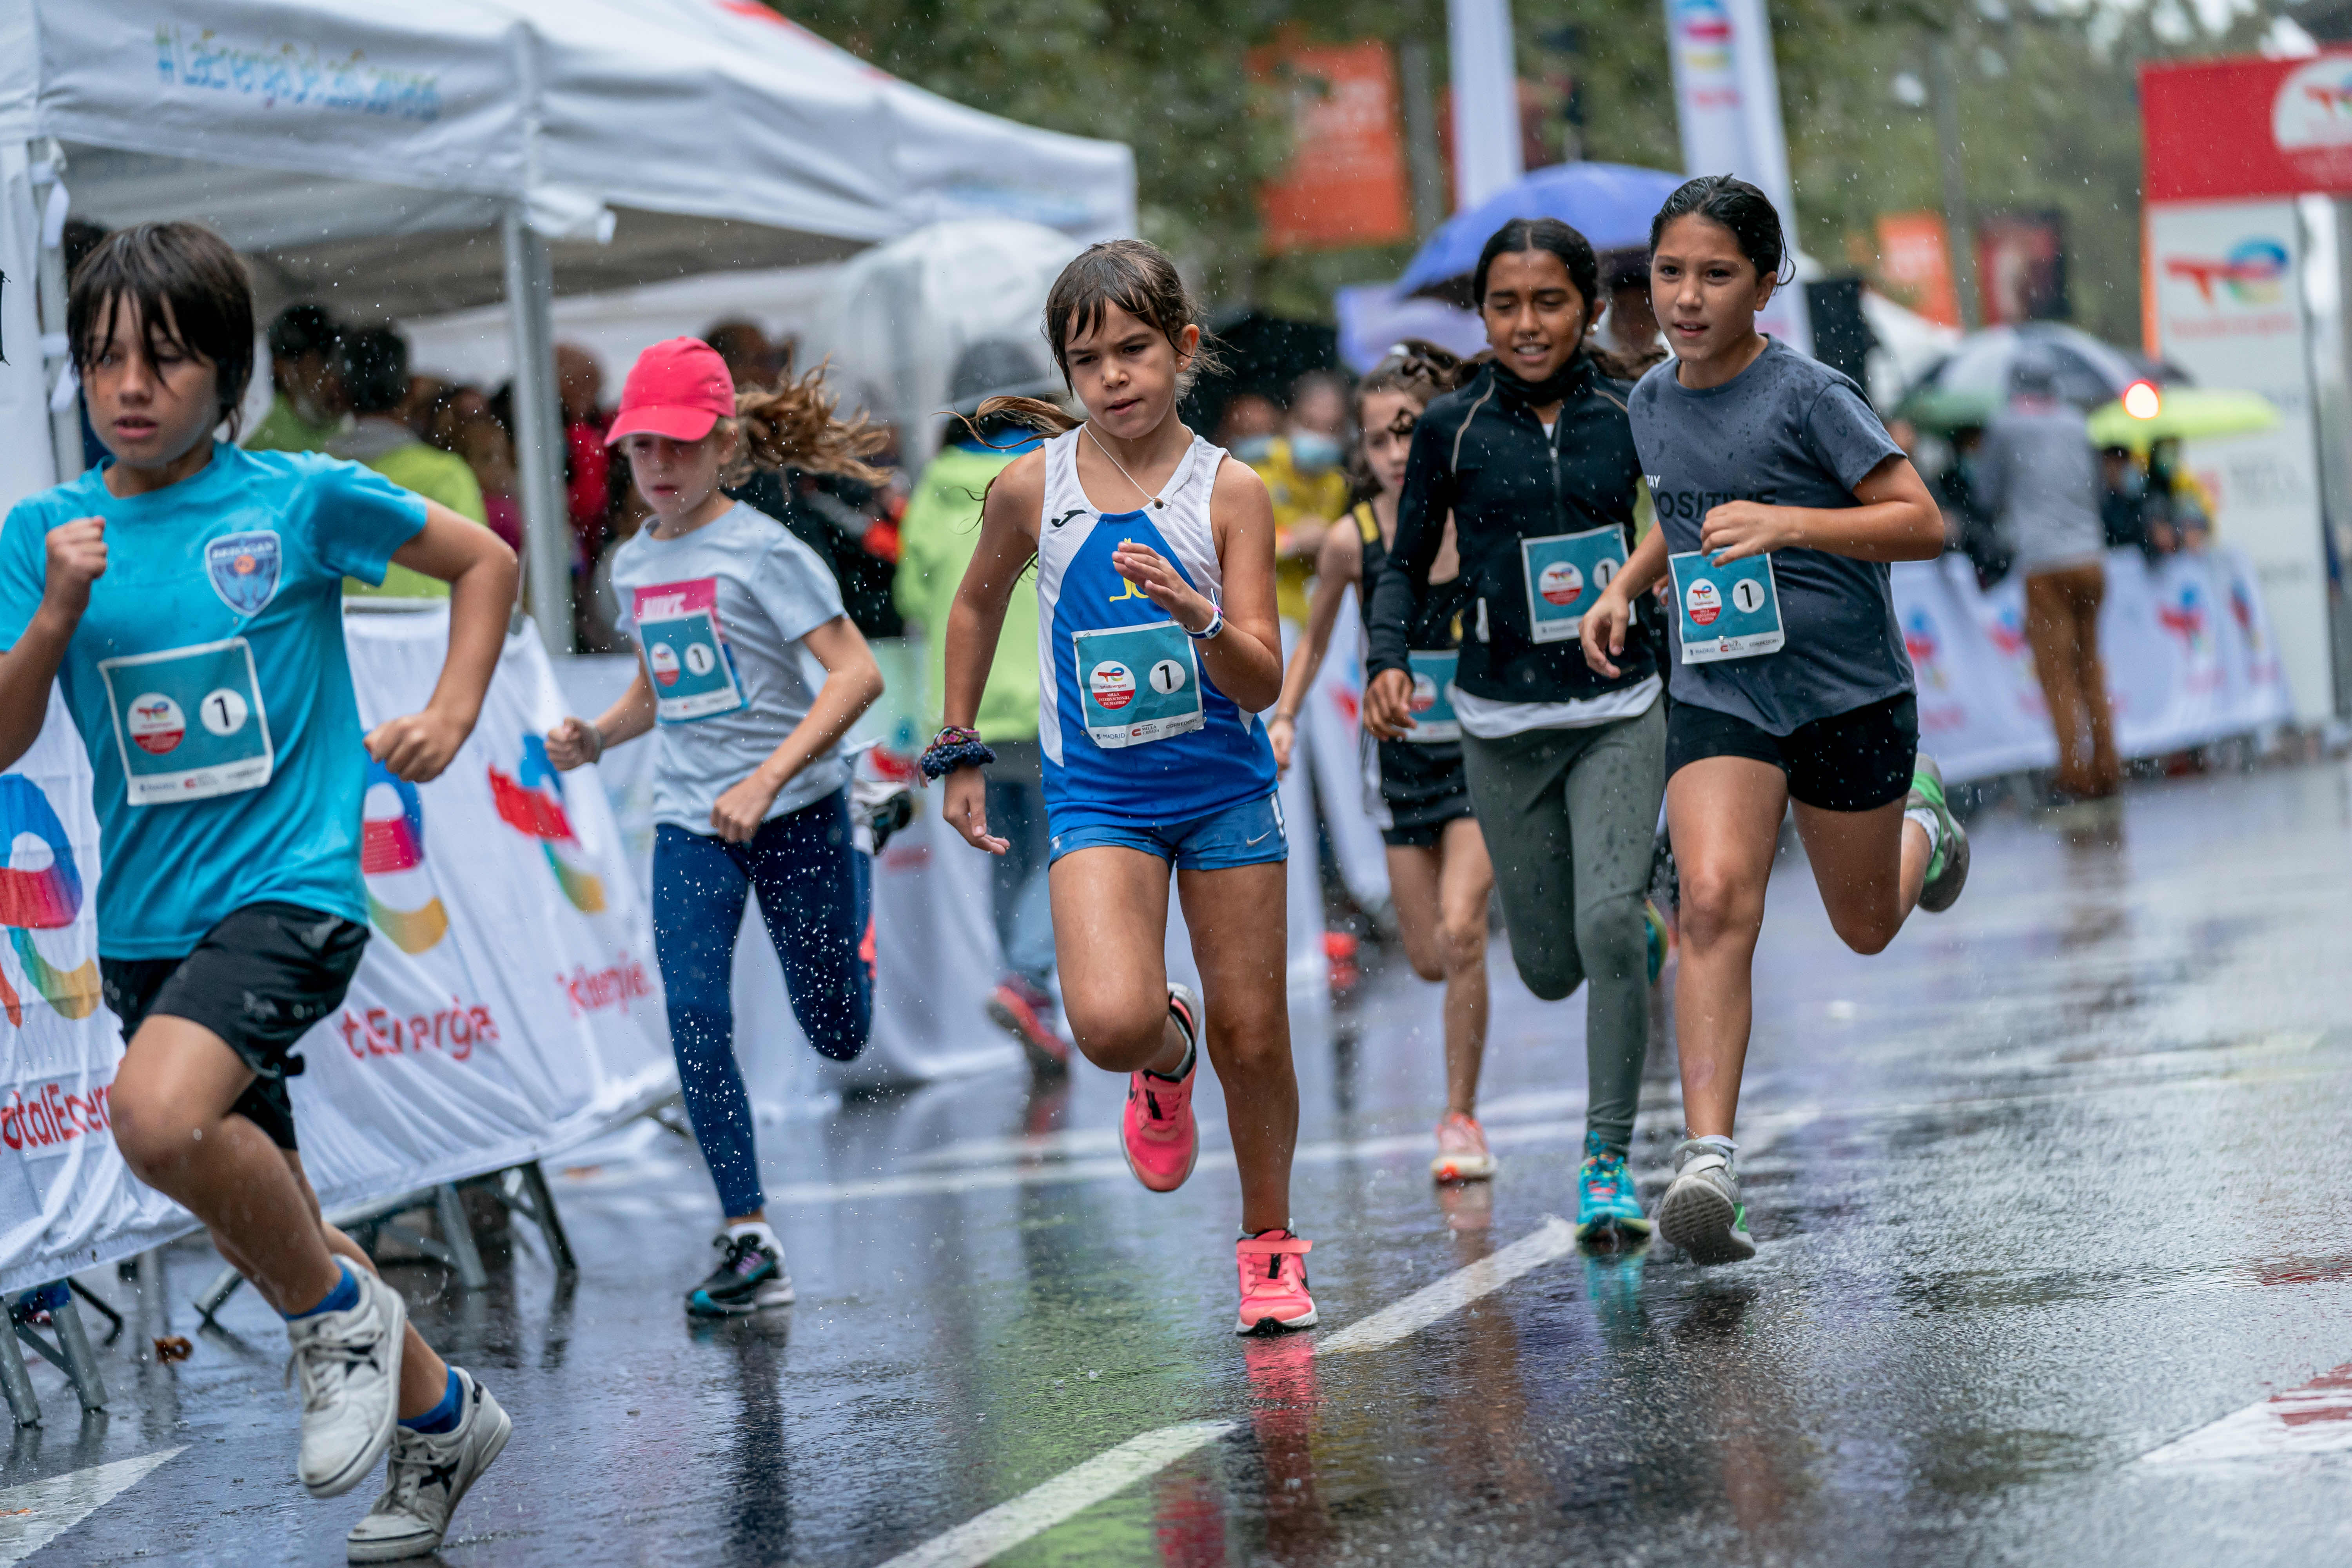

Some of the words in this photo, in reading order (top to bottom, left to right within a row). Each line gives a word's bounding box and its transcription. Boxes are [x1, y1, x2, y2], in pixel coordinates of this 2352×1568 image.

[1646, 474, 1661, 489] TAY
[1740, 583, 1753, 608] 1
[693, 648, 704, 668] 1
[1159, 664, 1172, 690] 1
[214, 696, 230, 727] 1
